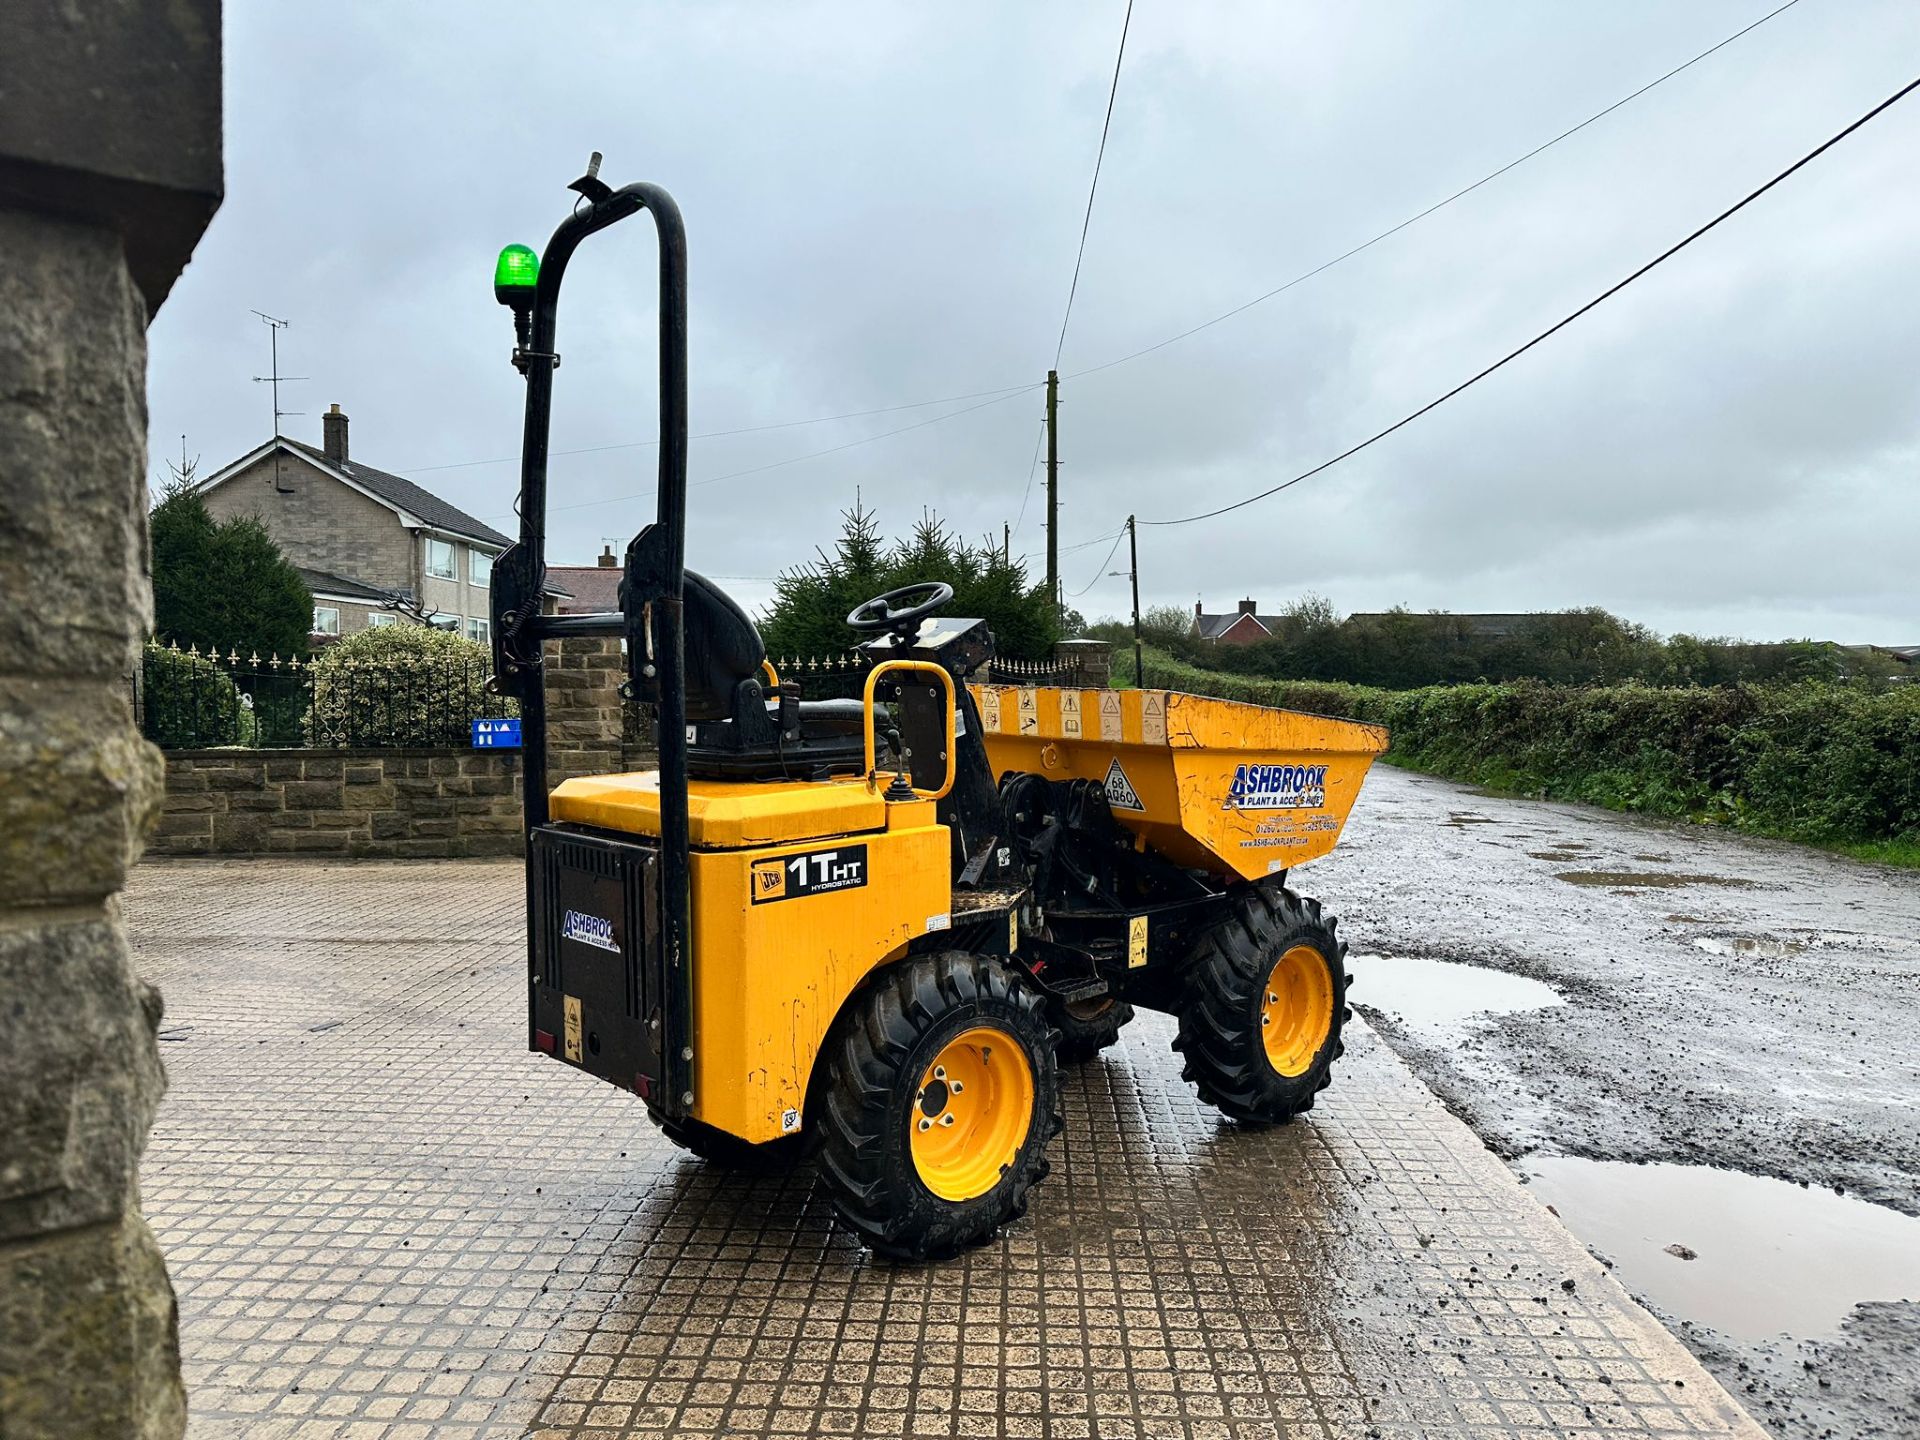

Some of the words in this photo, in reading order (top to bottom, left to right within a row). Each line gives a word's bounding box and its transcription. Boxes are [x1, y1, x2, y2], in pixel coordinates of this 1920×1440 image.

[1112, 776, 1124, 790] 68
[1223, 764, 1328, 807] ASHBROOK
[1106, 788, 1133, 804] AQ60
[1247, 796, 1271, 806] PLANT
[1272, 796, 1277, 805] &
[1279, 796, 1305, 806] ACCES
[763, 871, 781, 890] JCB
[810, 877, 862, 892] HYDROSTATIC
[573, 931, 587, 941] PLANT
